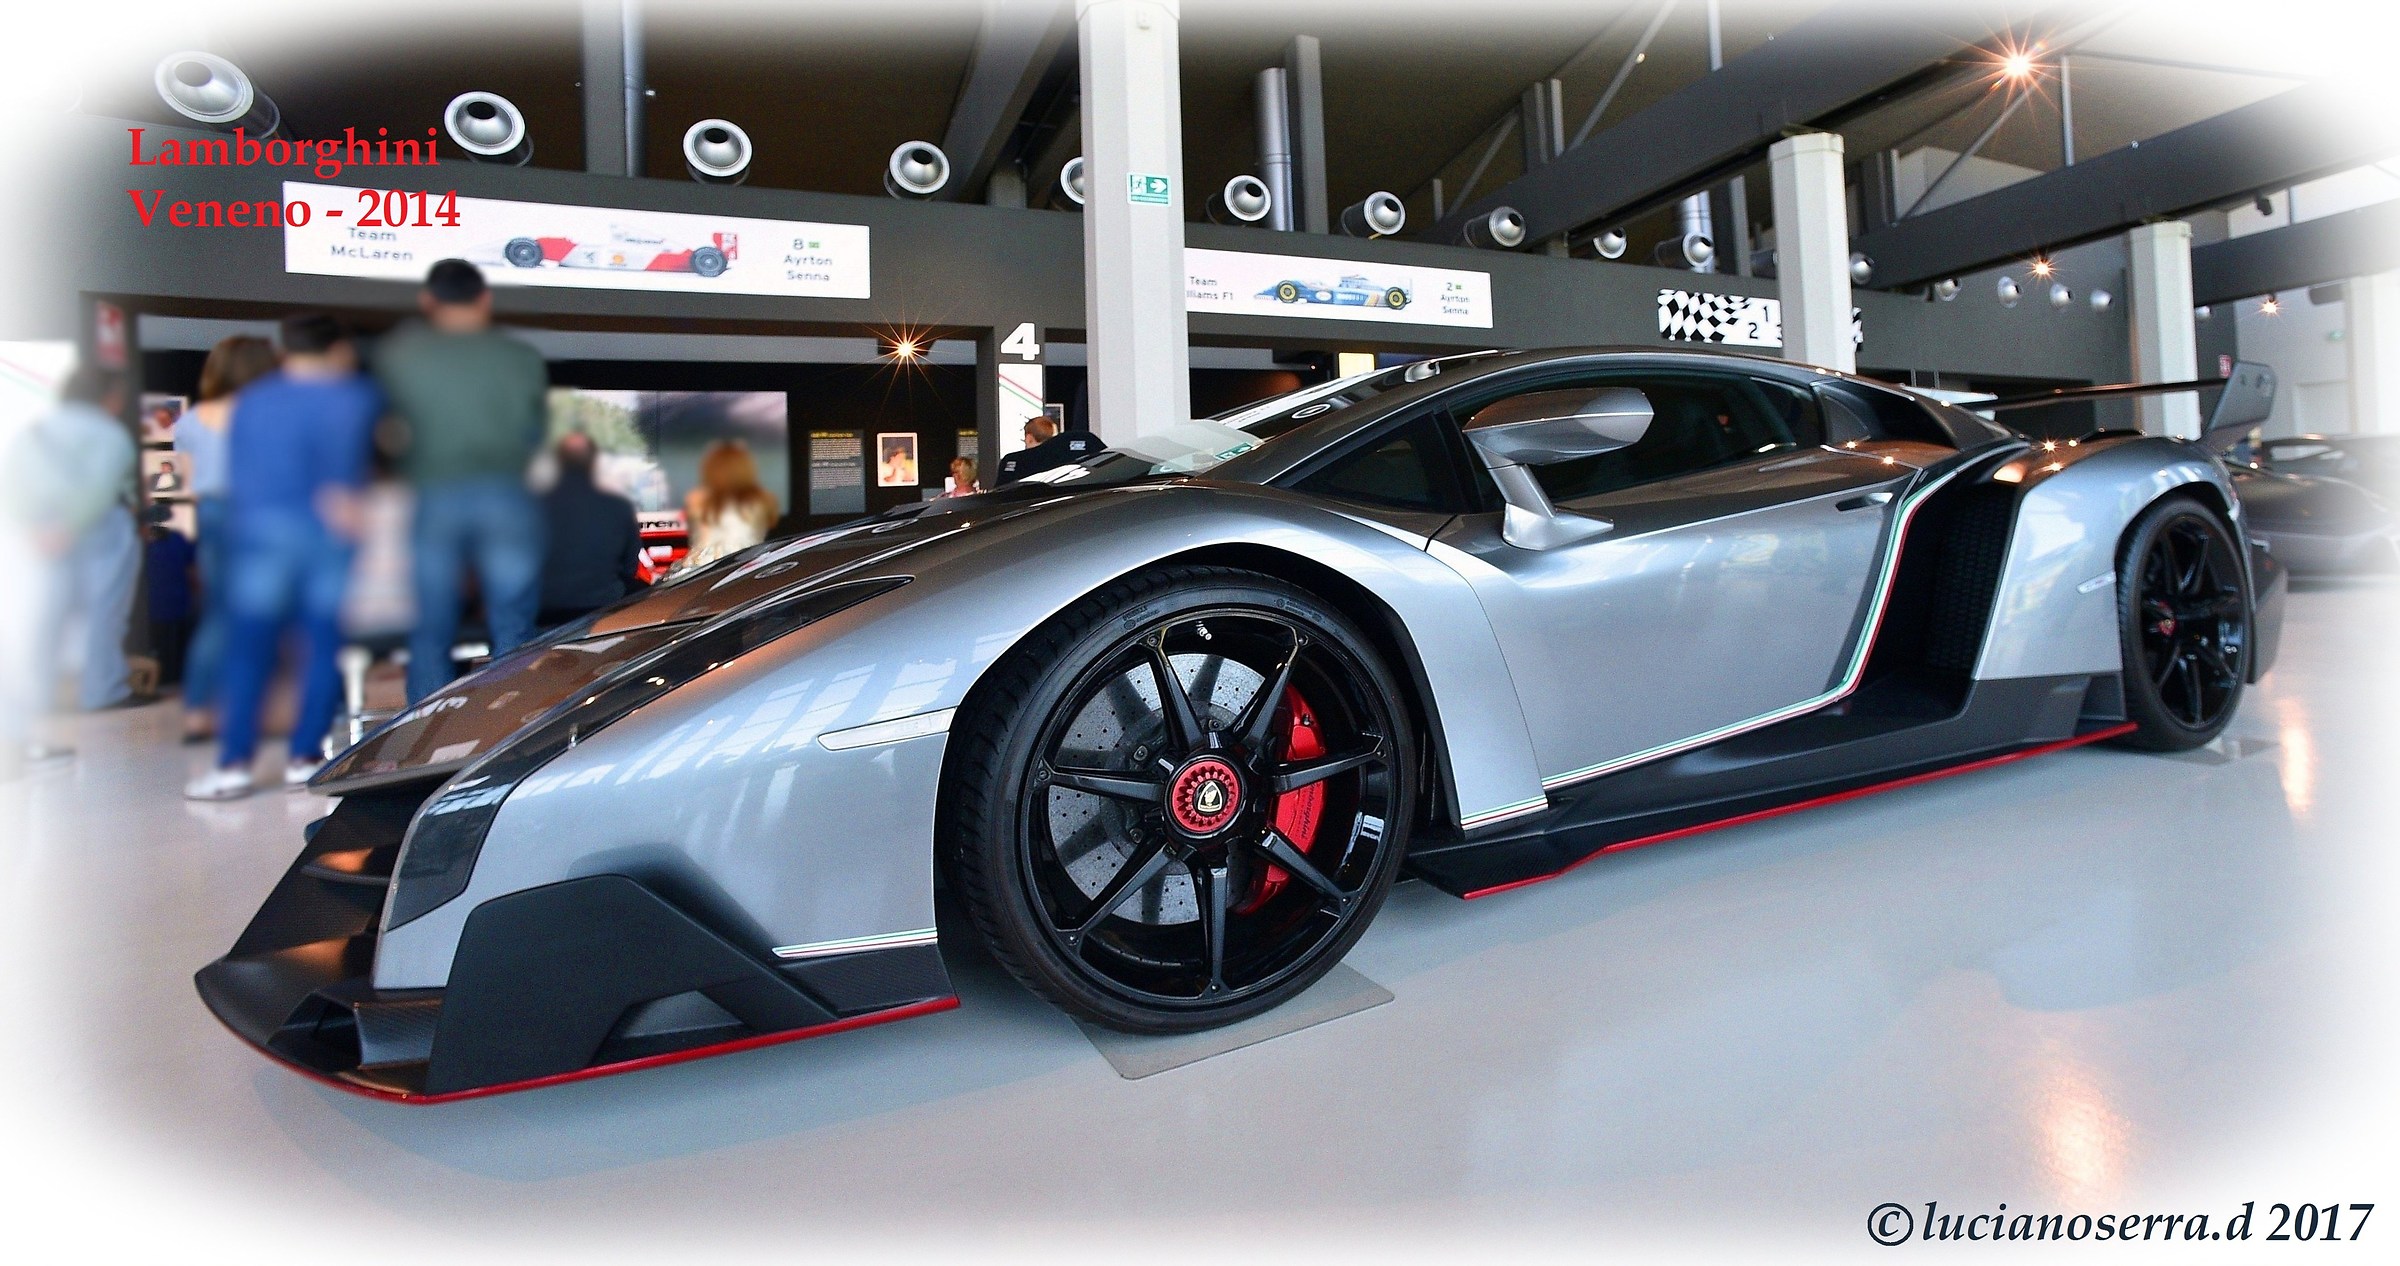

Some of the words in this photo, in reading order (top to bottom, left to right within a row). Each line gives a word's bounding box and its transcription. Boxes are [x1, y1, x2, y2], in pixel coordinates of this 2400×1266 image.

[348, 227, 397, 240] Team
[793, 239, 804, 250] 8
[331, 245, 413, 260] McLaren
[784, 255, 832, 266] Ayrton
[787, 270, 830, 281] Senna
[1190, 276, 1218, 286] Team
[1446, 282, 1453, 291] 2
[1763, 305, 1769, 322] 1
[1748, 322, 1759, 340] 2
[1000, 322, 1040, 361] 4
